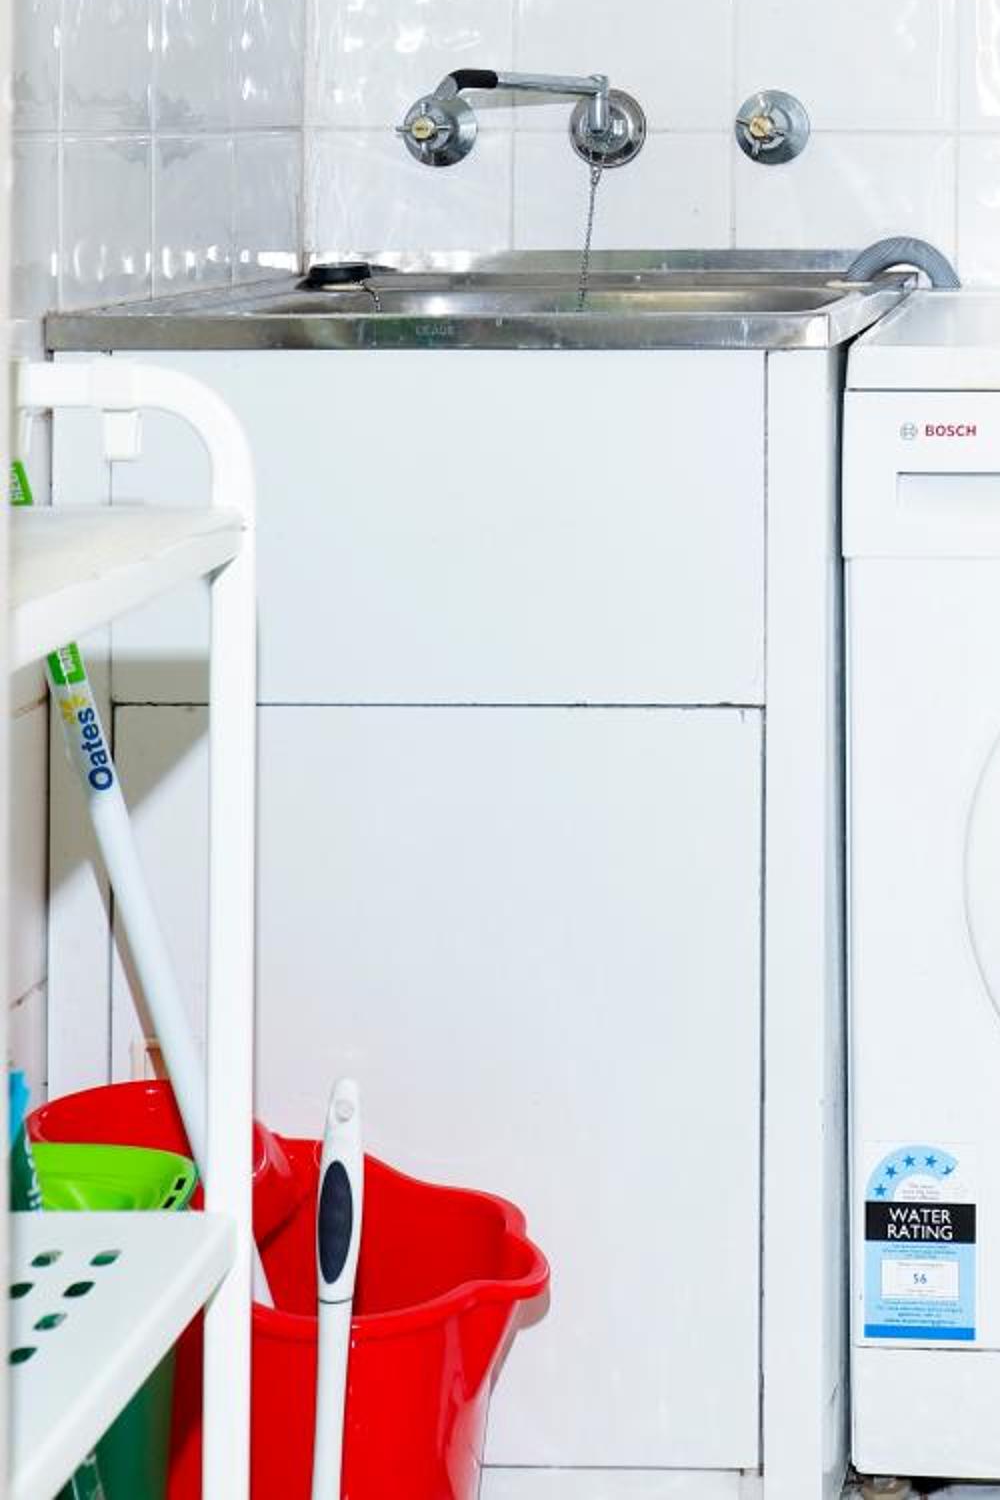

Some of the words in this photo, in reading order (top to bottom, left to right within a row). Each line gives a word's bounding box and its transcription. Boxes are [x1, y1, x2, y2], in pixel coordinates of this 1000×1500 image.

[924, 424, 977, 437] BOSCH
[77, 707, 113, 791] Oates
[889, 1208, 952, 1224] WATER
[887, 1224, 953, 1240] RATING
[913, 1273, 928, 1285] 56
